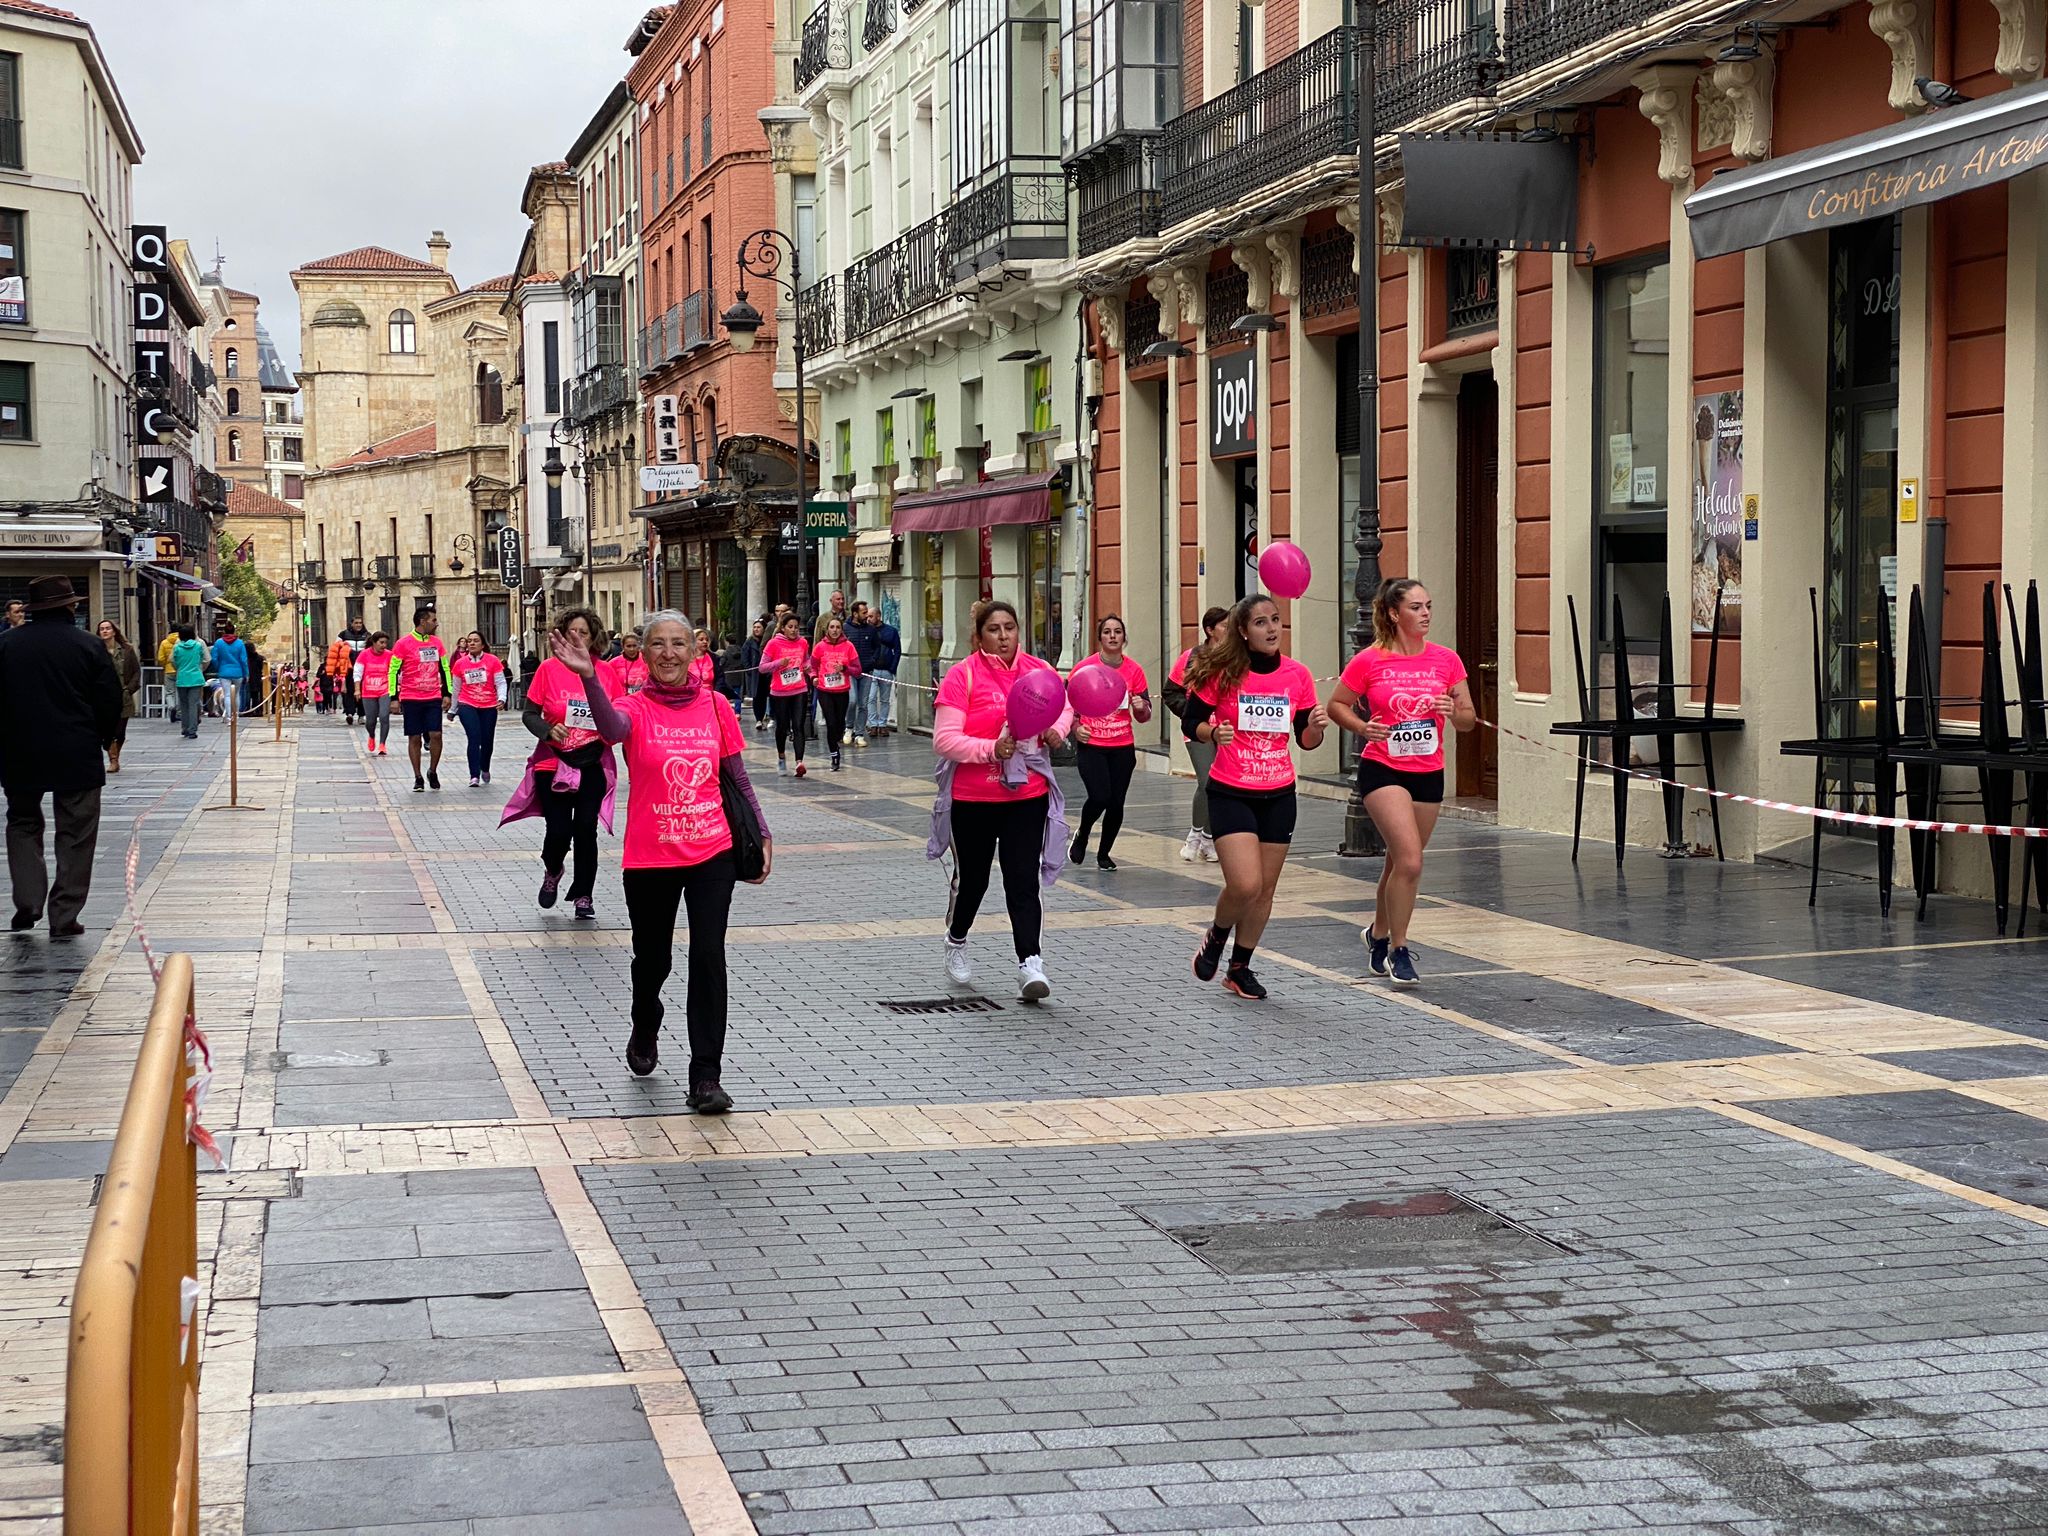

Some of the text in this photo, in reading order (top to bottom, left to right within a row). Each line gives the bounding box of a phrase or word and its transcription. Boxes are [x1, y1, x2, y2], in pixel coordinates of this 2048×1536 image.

[1215, 359, 1255, 445] jop!
[659, 398, 678, 462] IRIS
[1637, 481, 1654, 496] PAN
[805, 512, 847, 527] JOYERIA
[13, 533, 37, 544] COPAS
[503, 530, 516, 578] HOTEL
[1244, 705, 1284, 718] 4008
[1392, 729, 1433, 742] 4006
[652, 800, 718, 815] VIII CARRERA
[666, 816, 711, 834] Mujer
